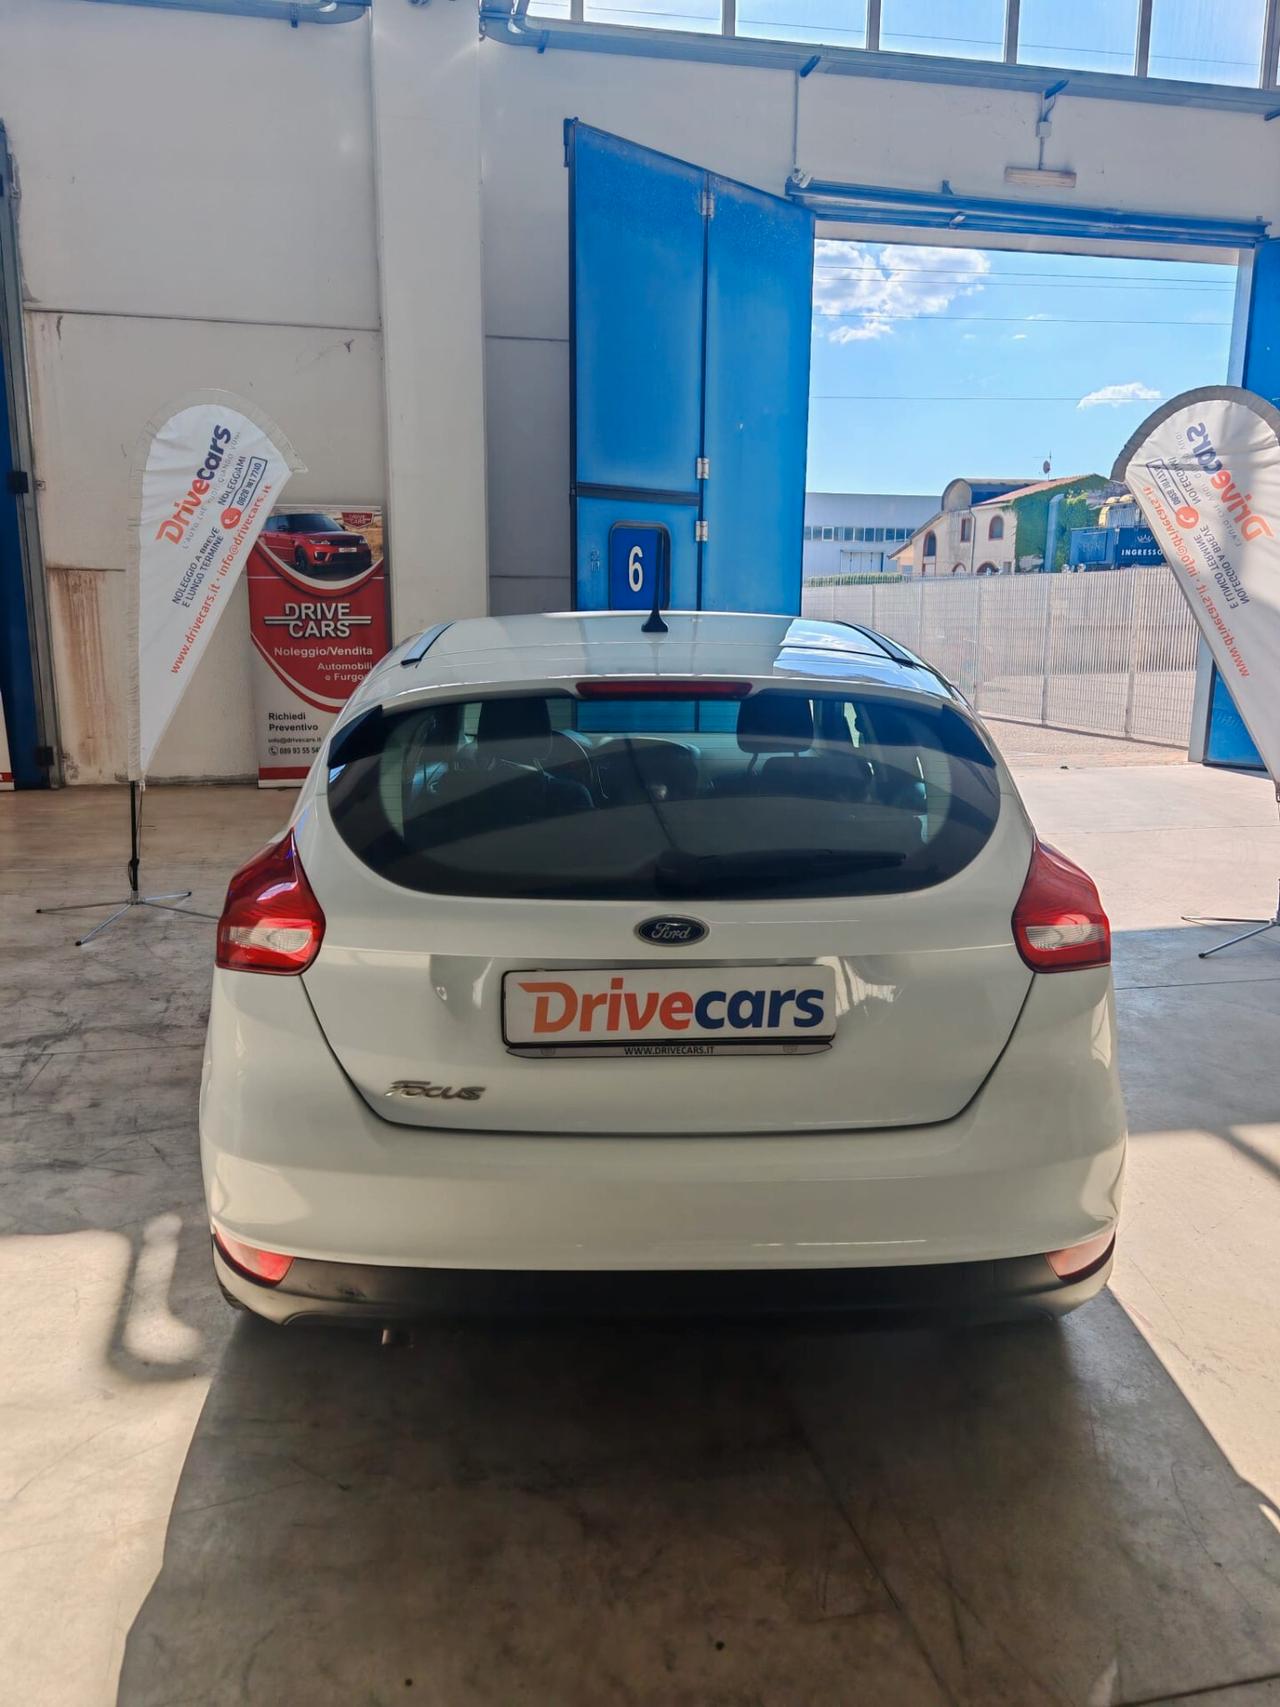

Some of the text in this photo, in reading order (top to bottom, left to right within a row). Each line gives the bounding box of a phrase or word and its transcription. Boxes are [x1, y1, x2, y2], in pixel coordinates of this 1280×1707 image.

[155, 424, 231, 545] Drivecars
[1121, 548, 1163, 556] INGRESSO
[172, 526, 220, 605] NOLEGGIO A BREVE
[181, 535, 225, 608] E LUNGO TERMINE
[628, 545, 643, 592] 6
[171, 484, 272, 674] www.drivecars.it info@drivecars.it
[285, 602, 351, 620] DRIVE
[289, 621, 351, 637] CARS
[274, 646, 373, 658] Noleggio/Vendita
[317, 661, 373, 671] Automobili
[334, 672, 368, 683] Furgo
[268, 712, 306, 721] Richiedi
[269, 722, 319, 731] Preventivo
[651, 922, 692, 939] Ford
[517, 977, 825, 1034] Drivecars
[624, 1046, 715, 1055] WWW.DRIVECARS.IT
